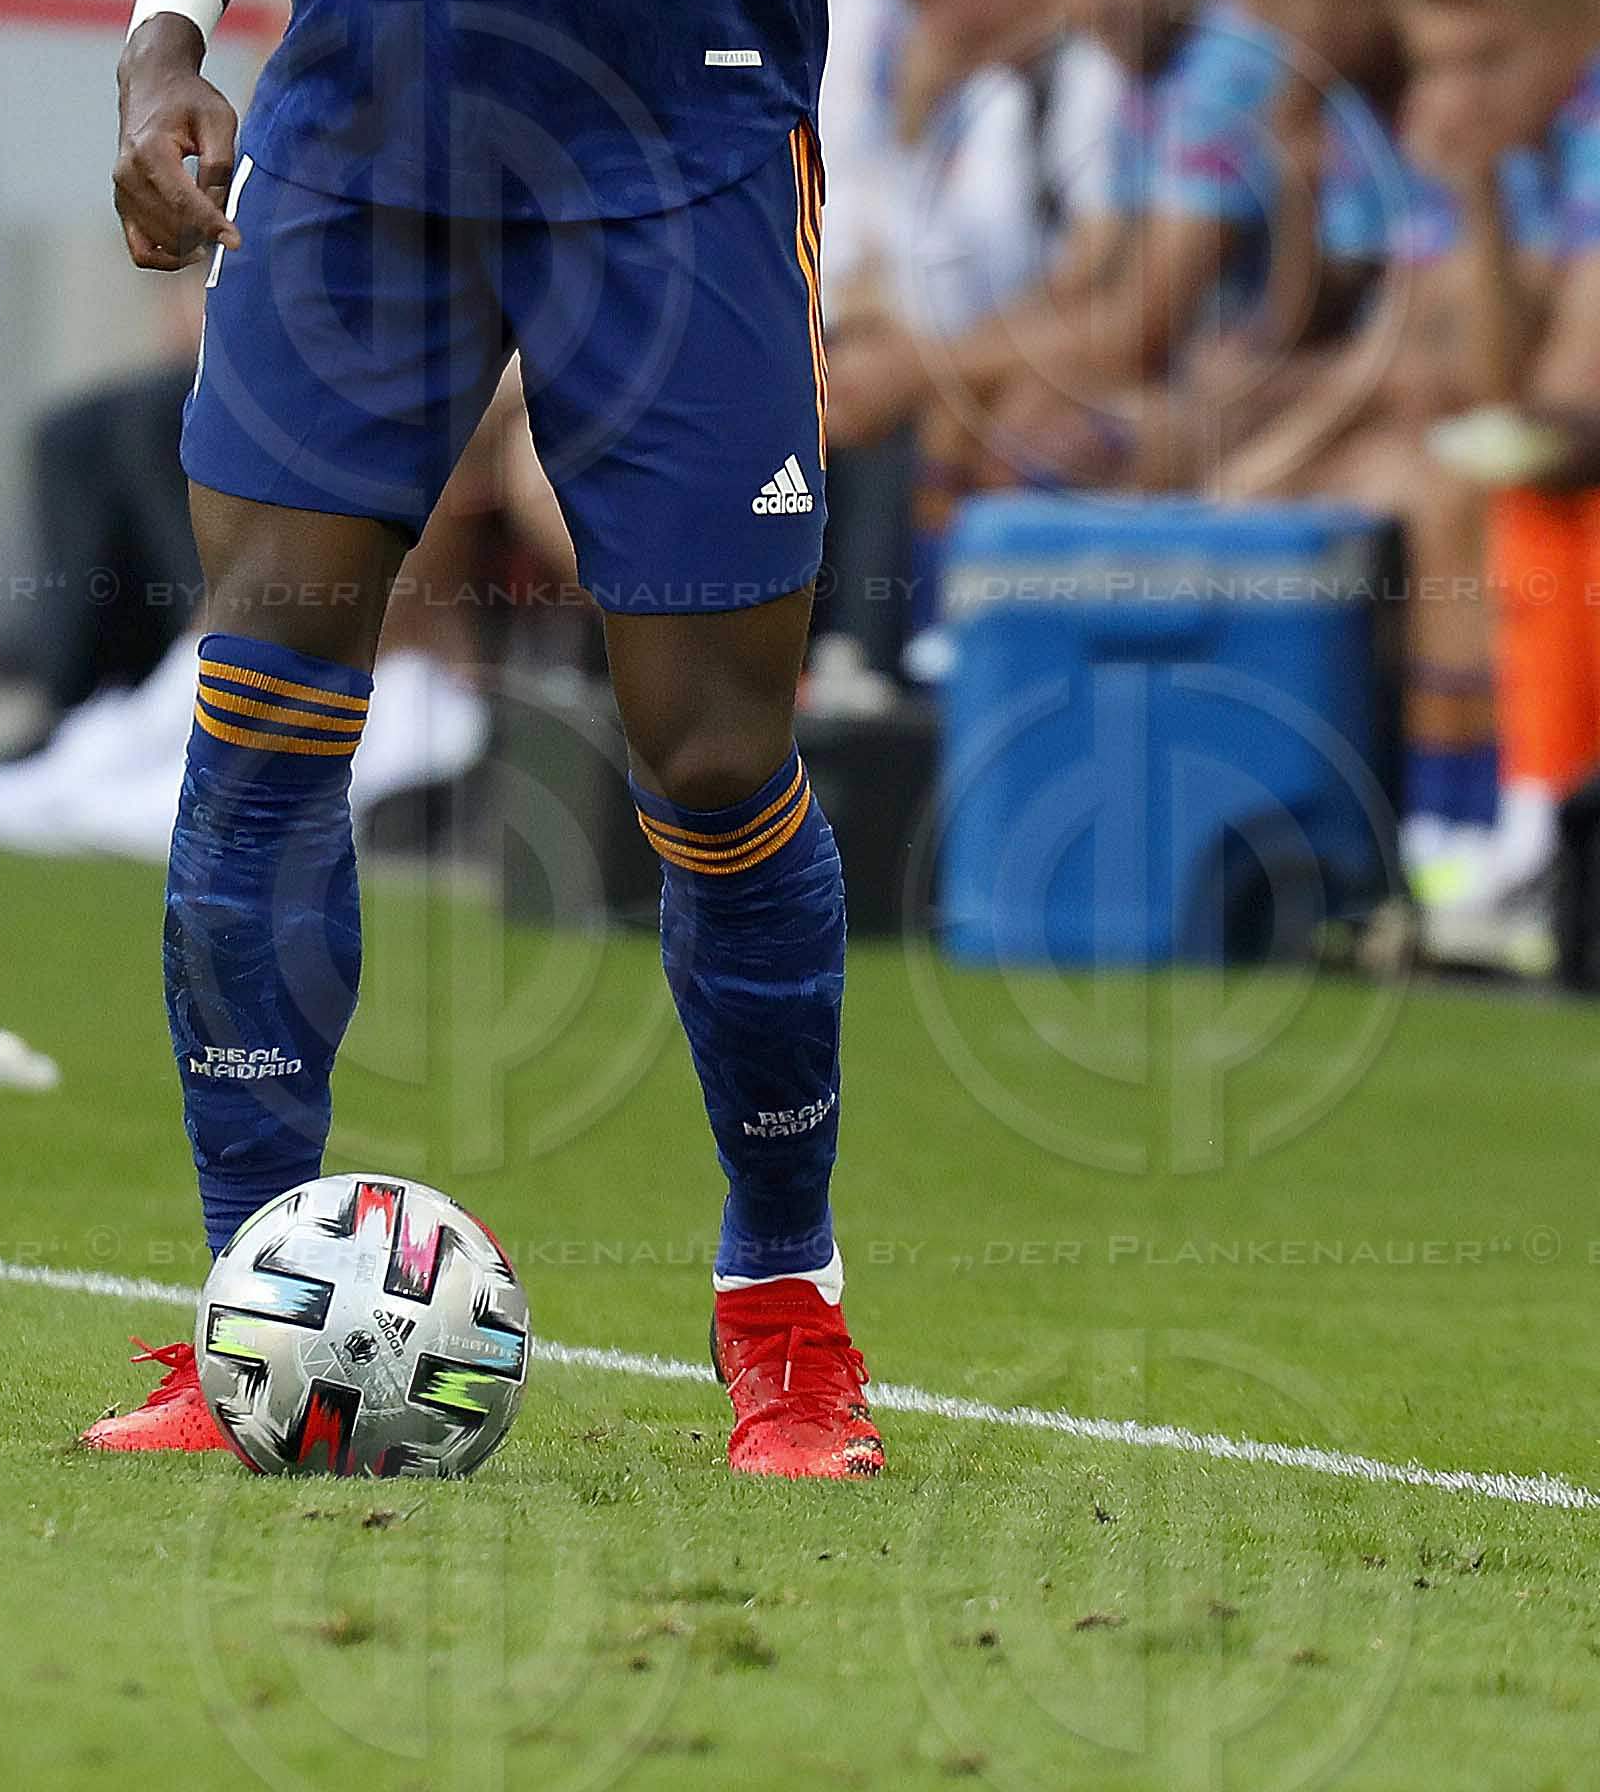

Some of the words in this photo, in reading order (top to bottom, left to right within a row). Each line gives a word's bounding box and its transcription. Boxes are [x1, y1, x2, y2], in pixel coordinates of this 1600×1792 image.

[752, 492, 813, 515] adidas
[204, 1046, 286, 1063] REAL
[189, 1058, 302, 1080] MADRID
[373, 1309, 405, 1358] adidas
